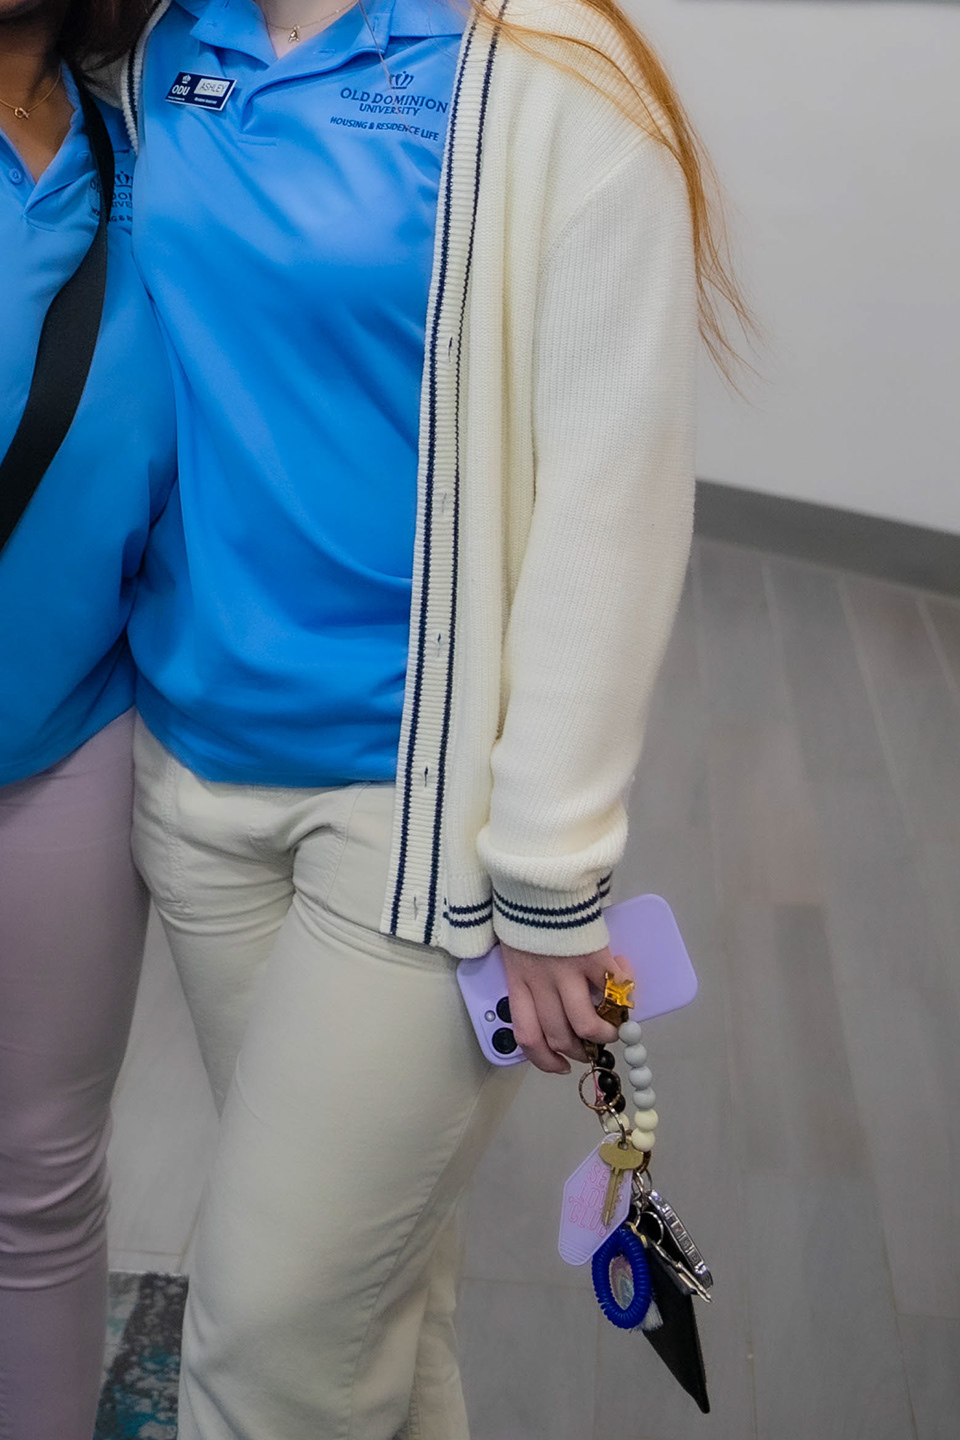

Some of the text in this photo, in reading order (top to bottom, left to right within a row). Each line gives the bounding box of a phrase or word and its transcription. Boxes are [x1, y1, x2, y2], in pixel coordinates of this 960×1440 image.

[171, 84, 191, 96] ODU
[340, 87, 449, 114] OLD DOMINION
[359, 102, 421, 116] UNIVERSITY
[330, 116, 440, 141] HOUSING & RESIDENCE LIFE
